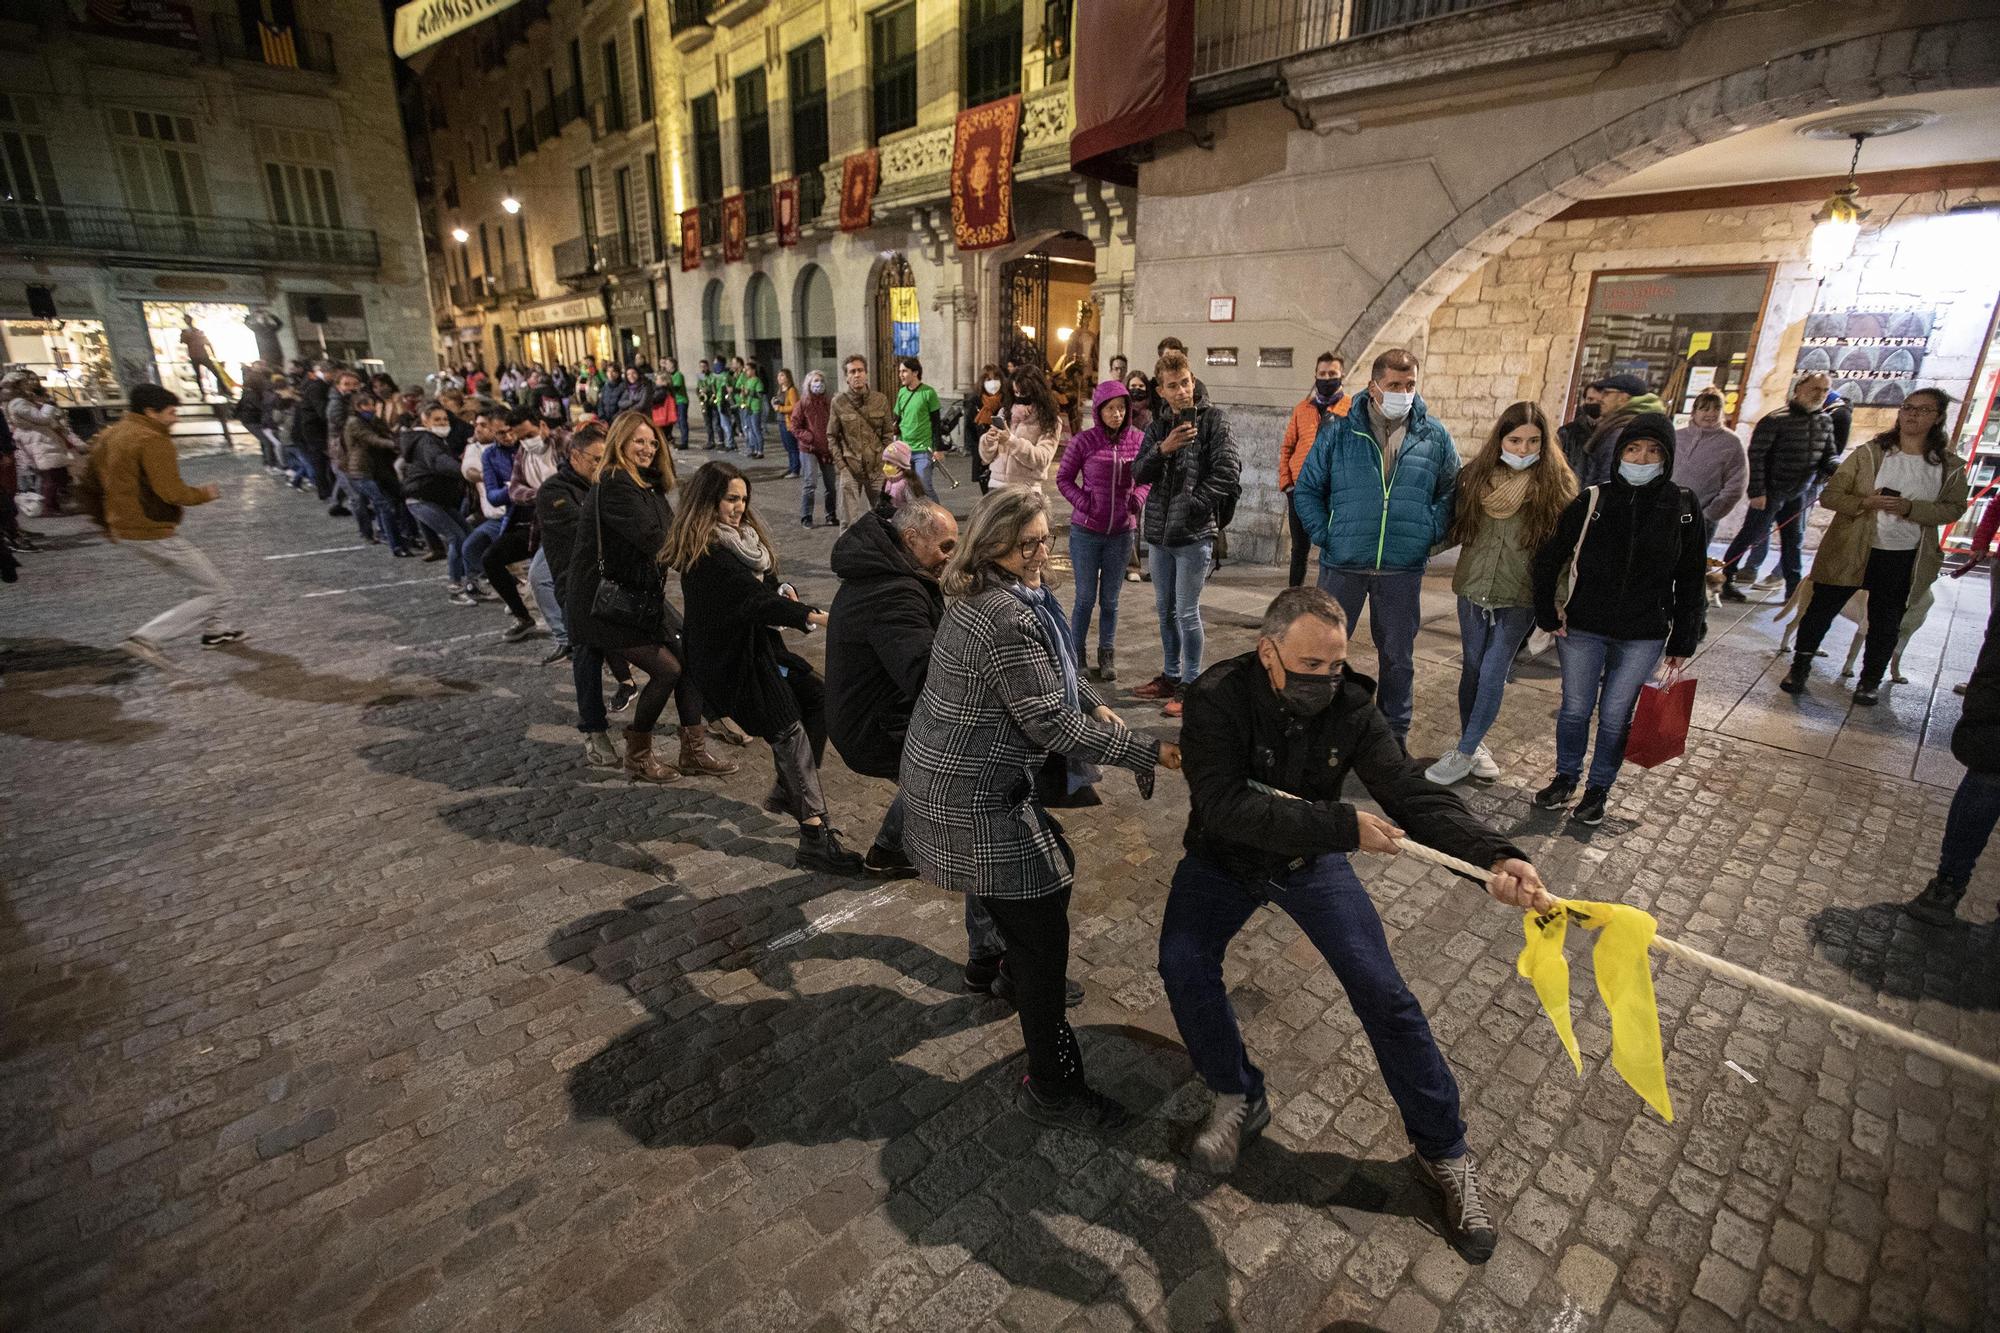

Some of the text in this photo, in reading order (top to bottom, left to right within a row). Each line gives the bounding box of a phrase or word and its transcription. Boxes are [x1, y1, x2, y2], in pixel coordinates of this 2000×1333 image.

[1803, 337, 1926, 347] LES VOLTES
[1837, 369, 1913, 379] VOLTES
